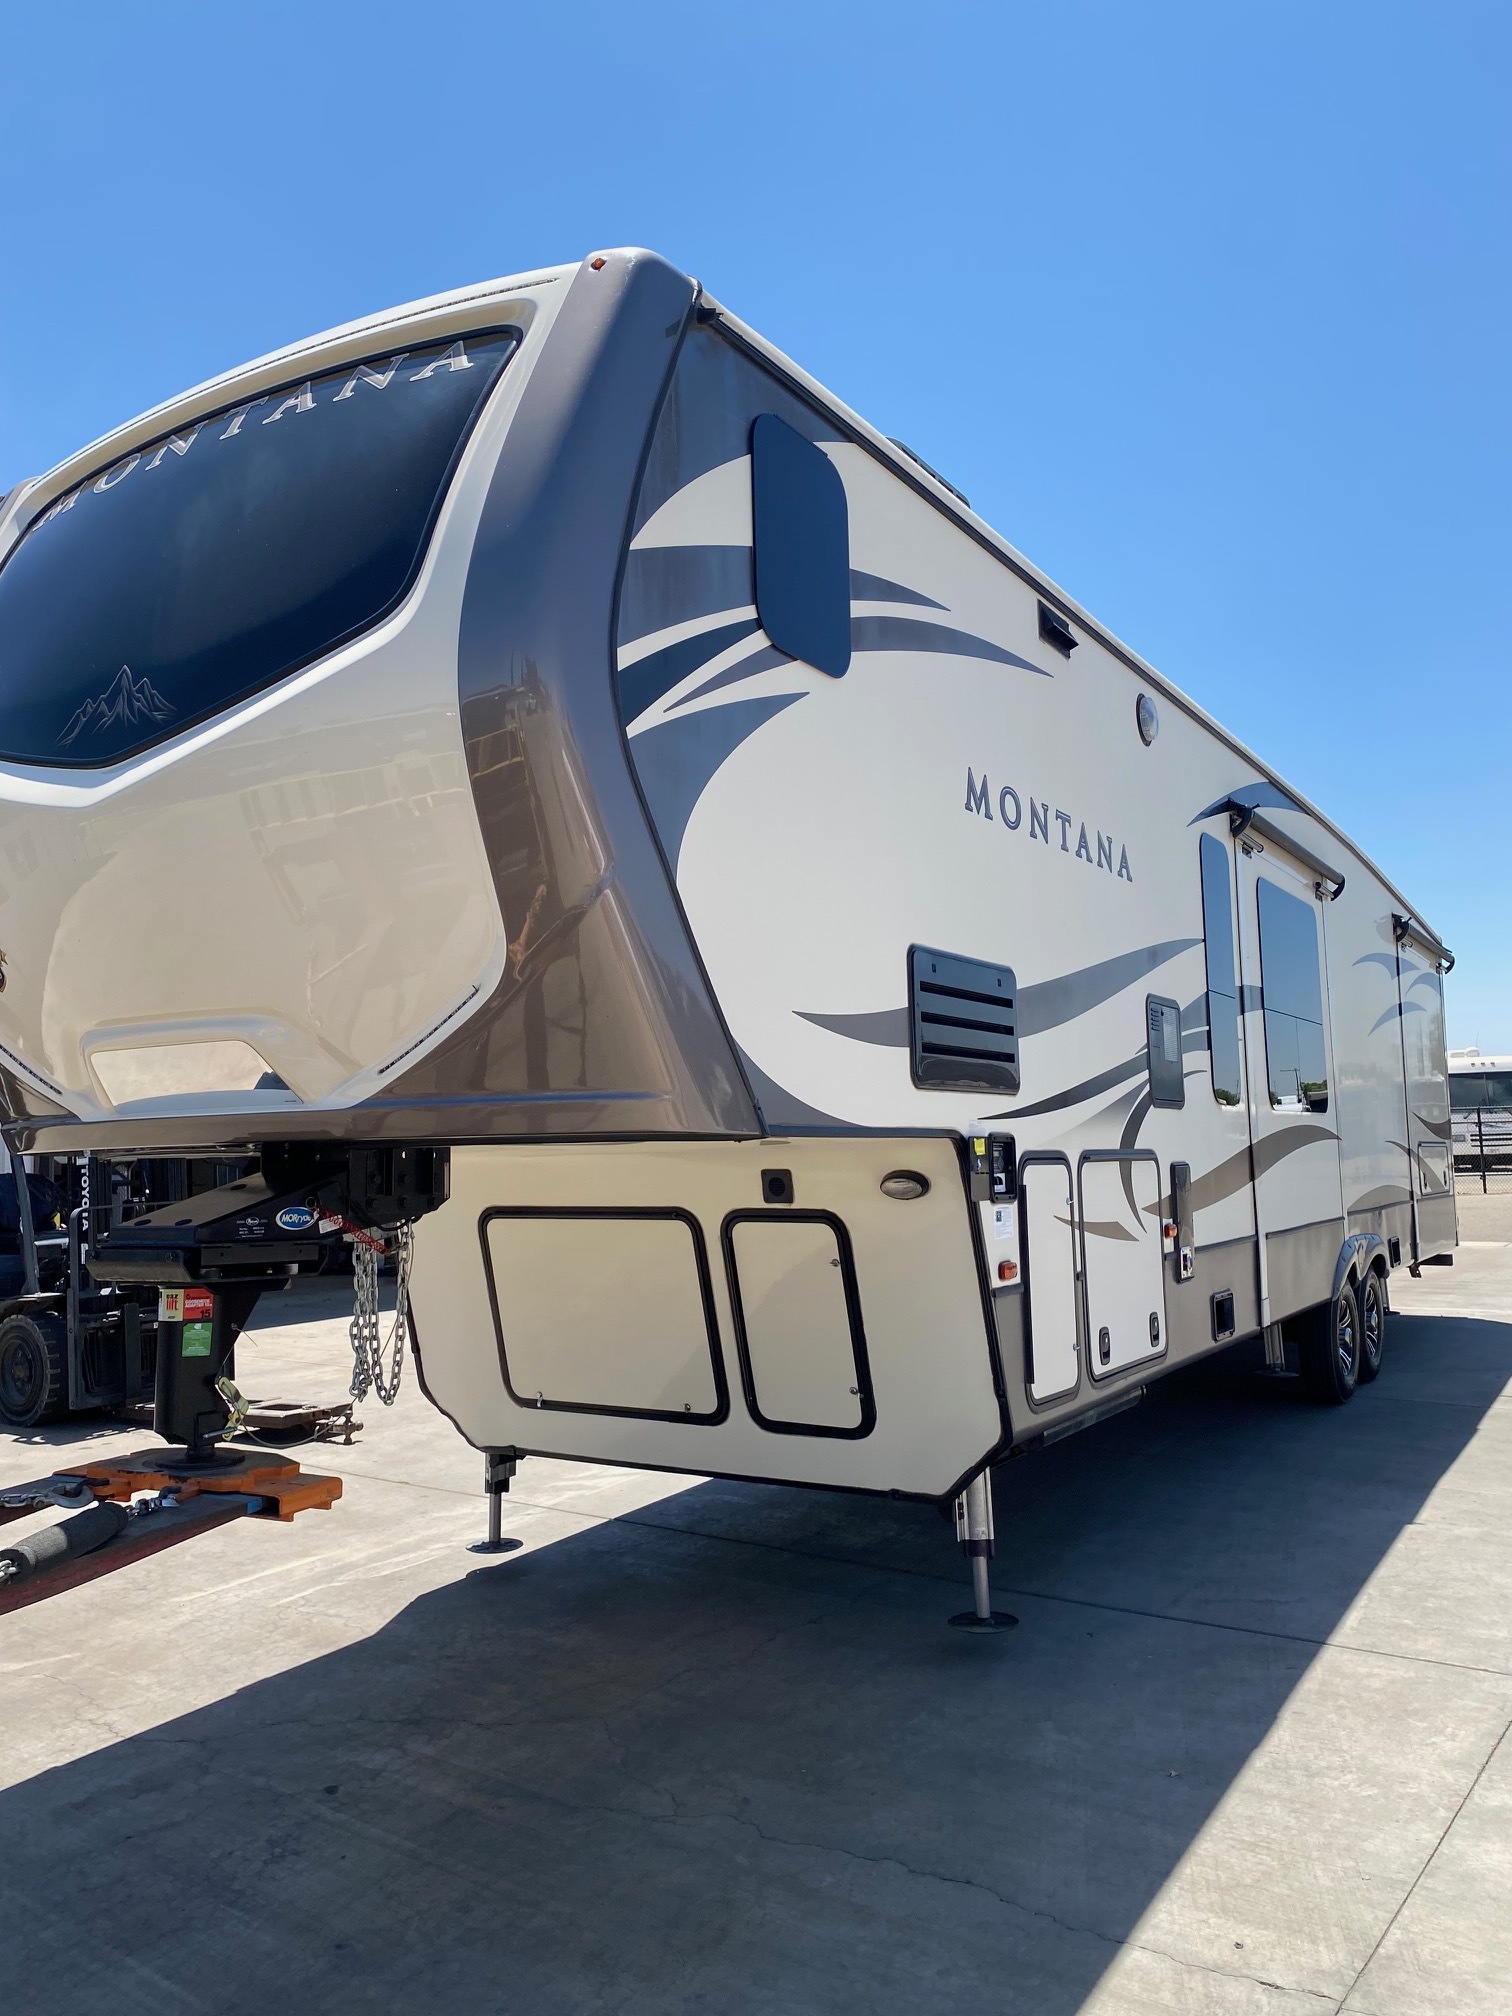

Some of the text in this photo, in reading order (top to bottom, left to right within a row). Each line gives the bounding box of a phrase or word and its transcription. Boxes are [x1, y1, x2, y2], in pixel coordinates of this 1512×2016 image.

[31, 340, 475, 532] MONTANA
[964, 766, 1133, 883] MONTANA
[200, 1308, 211, 1319] 15
